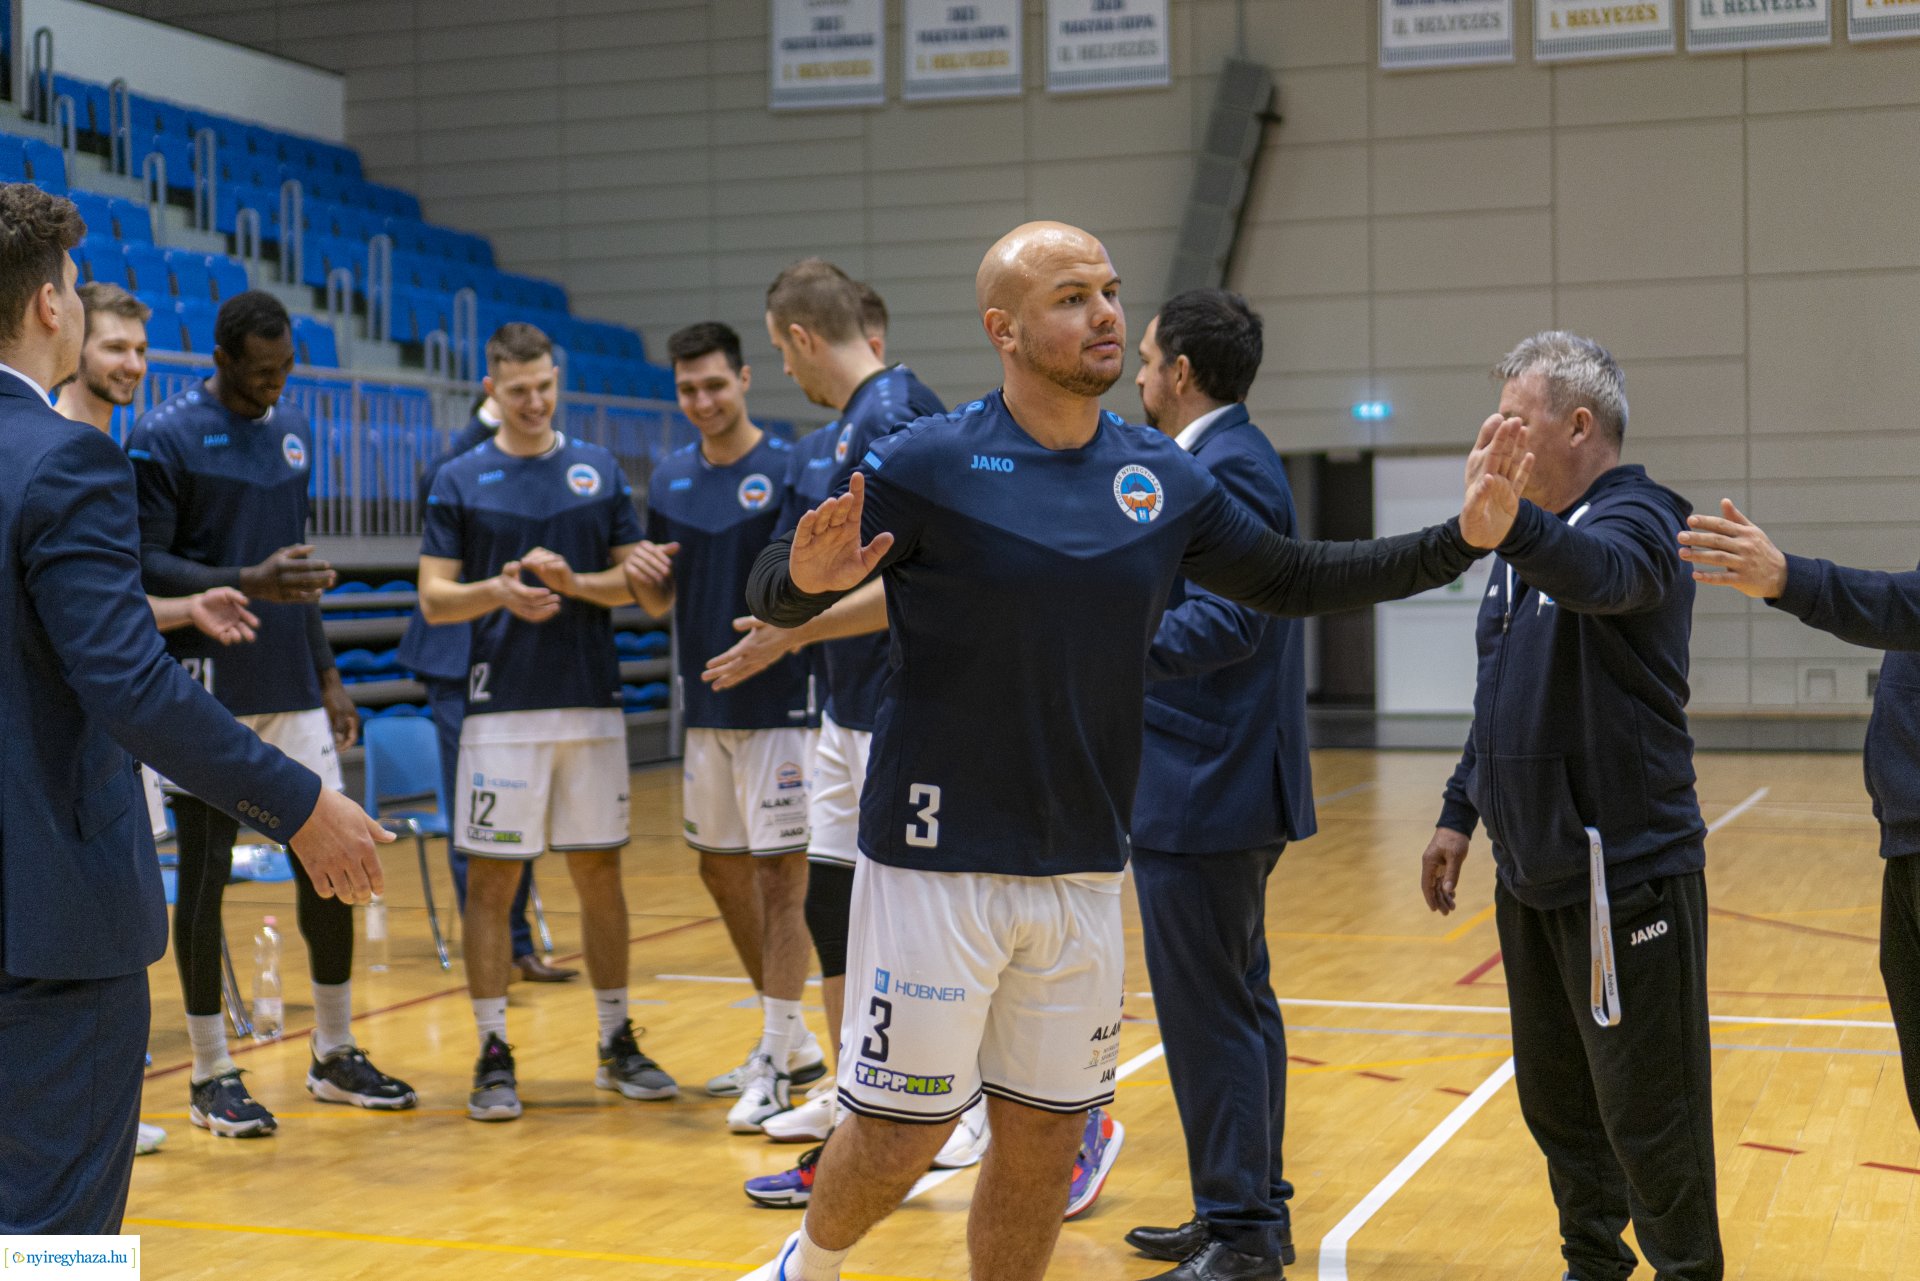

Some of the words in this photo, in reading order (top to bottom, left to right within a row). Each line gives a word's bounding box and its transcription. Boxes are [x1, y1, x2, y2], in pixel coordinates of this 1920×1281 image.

[970, 454, 1015, 473] JAKO
[469, 661, 491, 703] 12
[470, 790, 496, 827] 12
[905, 783, 941, 848] 3
[1630, 920, 1668, 946] JAKO
[895, 979, 966, 1002] HÜBNER
[861, 996, 892, 1062] 3
